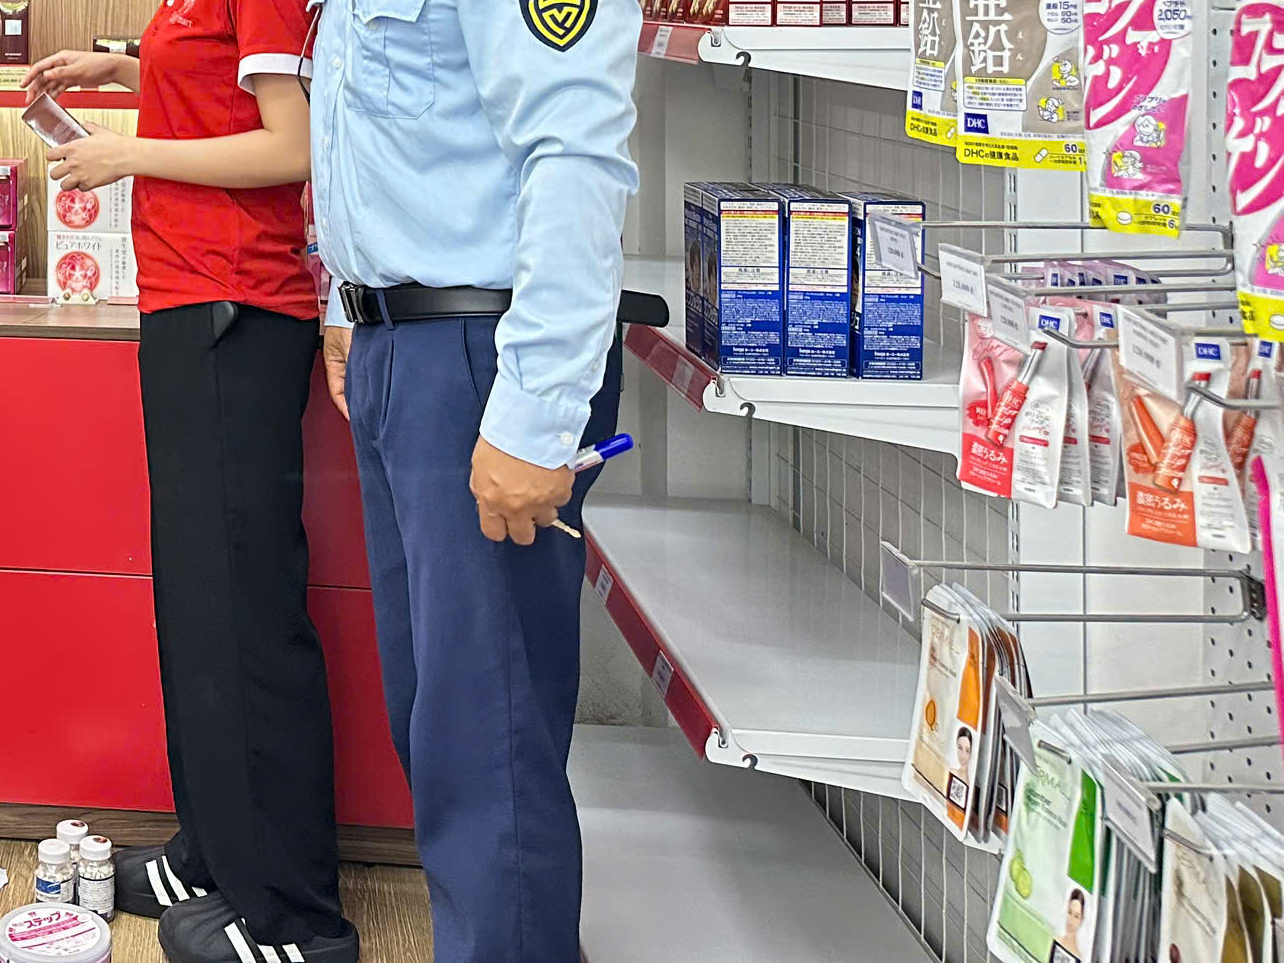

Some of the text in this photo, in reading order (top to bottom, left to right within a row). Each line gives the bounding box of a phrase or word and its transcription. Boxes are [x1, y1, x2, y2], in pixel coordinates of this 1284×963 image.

[967, 118, 986, 129] DHC
[964, 148, 1019, 162] DHCの健康食品
[1197, 345, 1219, 356] DHC
[23, 911, 62, 929] ステップ
